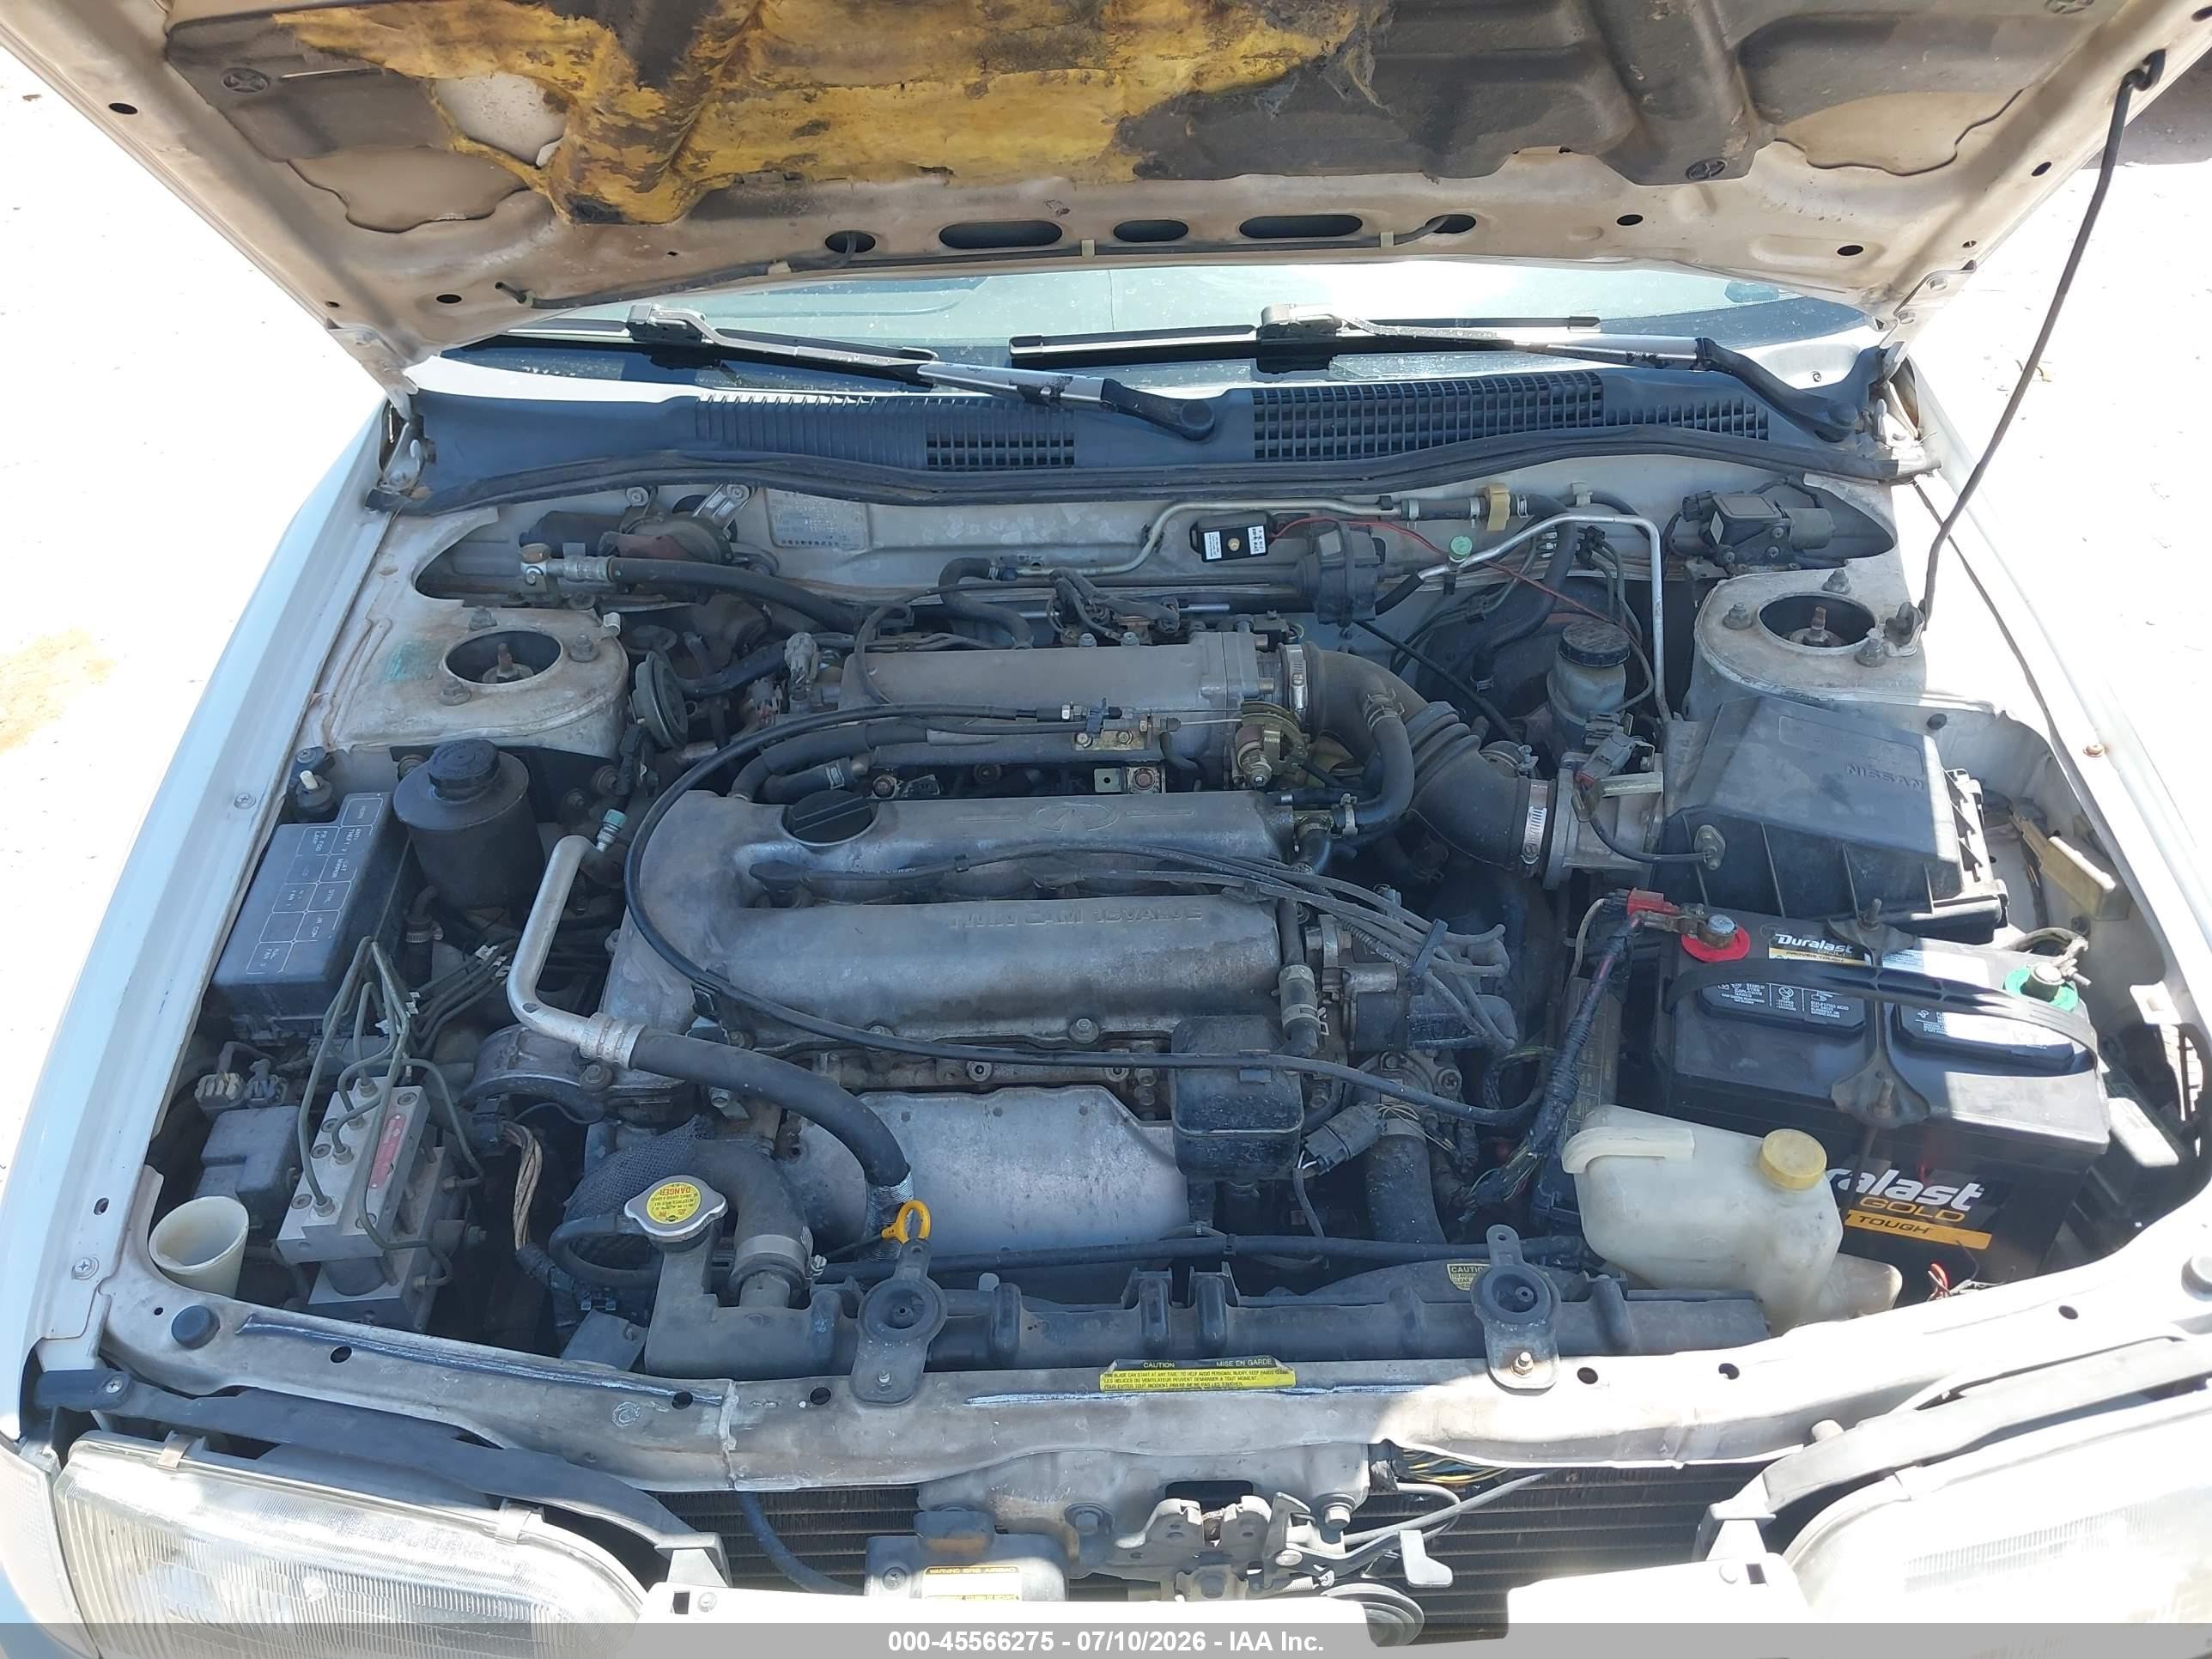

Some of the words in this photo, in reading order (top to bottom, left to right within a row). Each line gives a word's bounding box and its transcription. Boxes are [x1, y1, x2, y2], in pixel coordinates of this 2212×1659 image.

[1846, 763, 1924, 791] NISSAN
[1774, 933, 1854, 954] Duralast
[659, 1187, 691, 1195] DANGER
[1826, 1168, 1981, 1212] ralast
[1859, 1196, 1966, 1223] GOLD
[1858, 1214, 1929, 1235] TOUGH
[1247, 1358, 1272, 1367] GARDE
